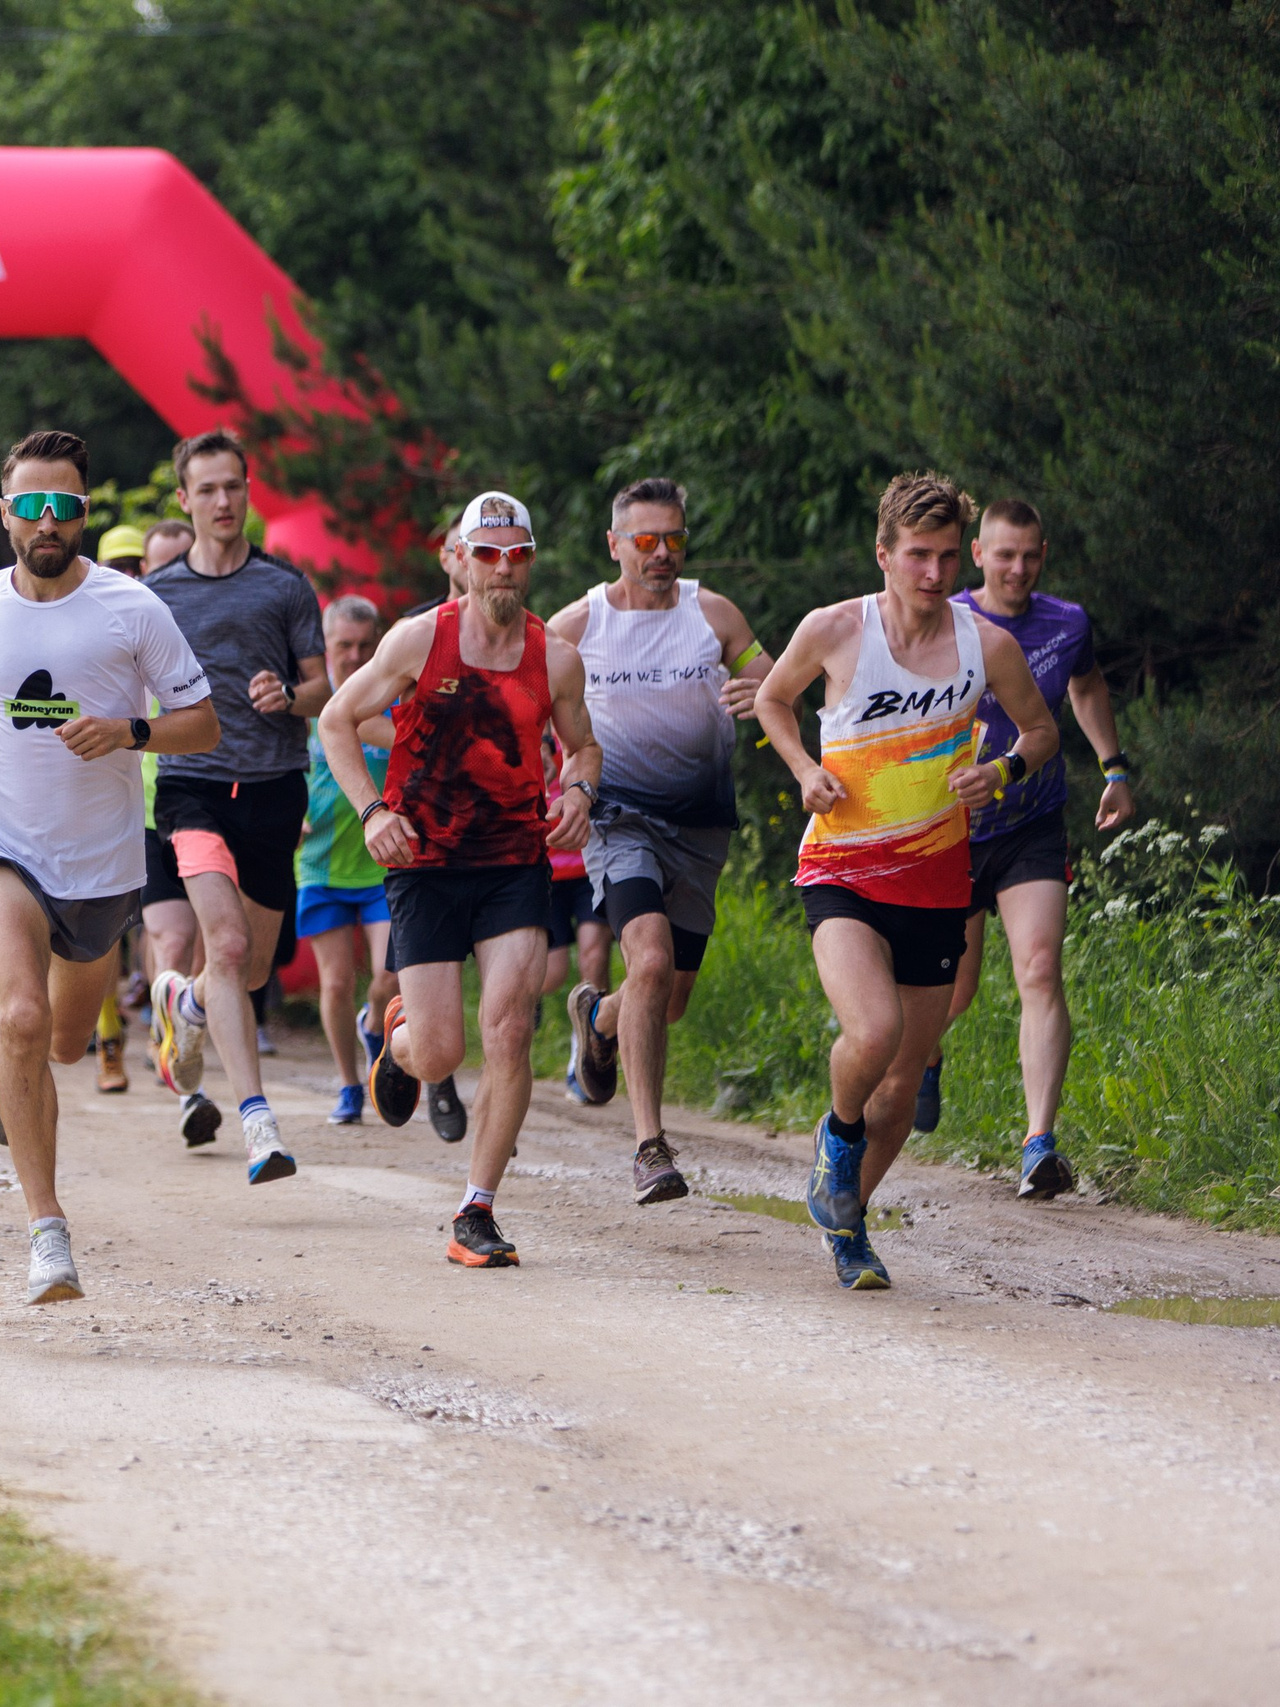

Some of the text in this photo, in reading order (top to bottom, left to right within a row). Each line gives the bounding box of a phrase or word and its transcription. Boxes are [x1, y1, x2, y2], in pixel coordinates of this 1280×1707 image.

[1027, 631, 1068, 667] ARAFON
[1032, 652, 1059, 679] 2020
[637, 669, 663, 683] WE
[10, 702, 74, 716] Moneyrun
